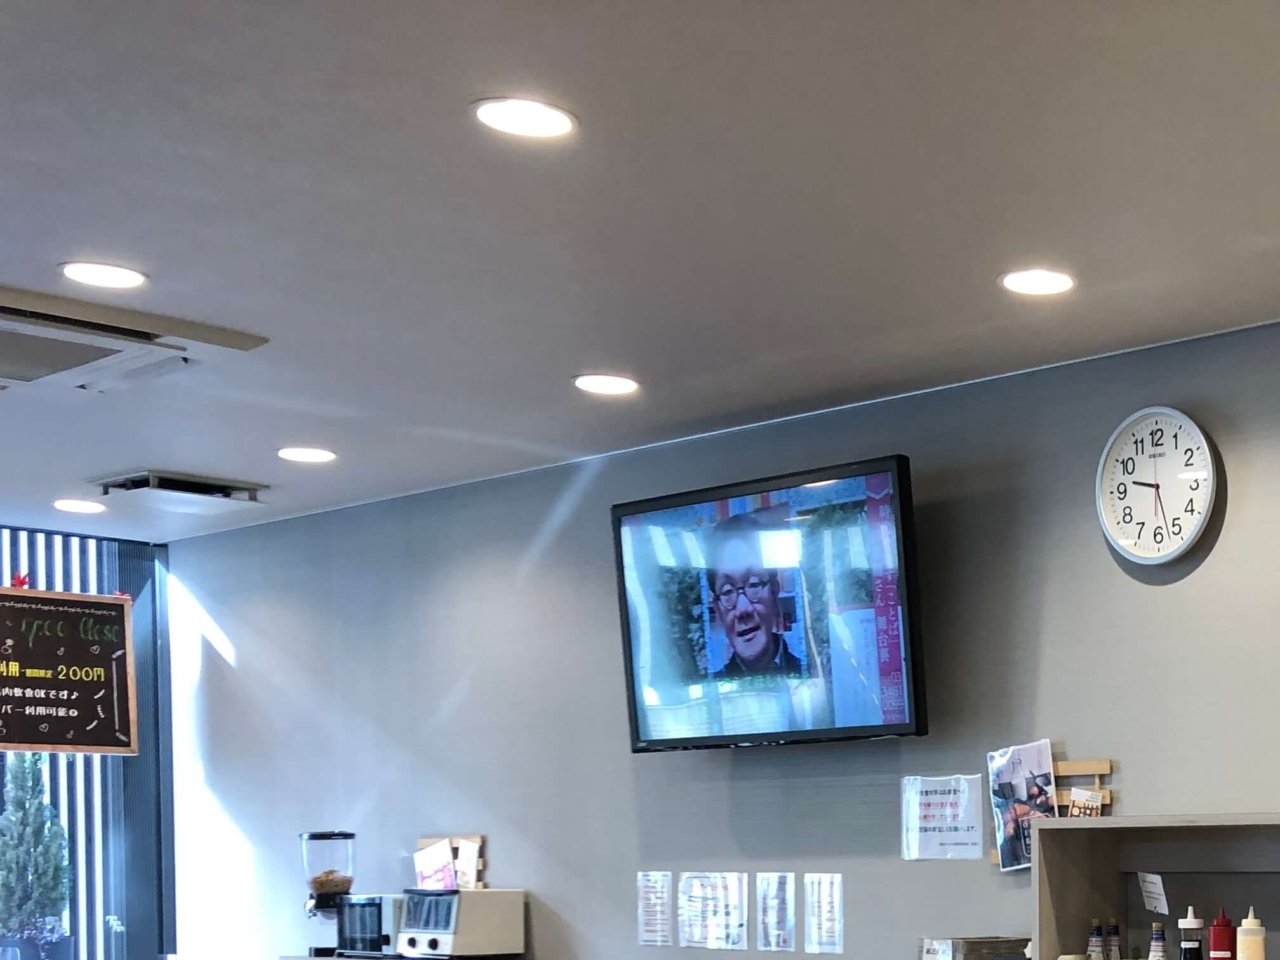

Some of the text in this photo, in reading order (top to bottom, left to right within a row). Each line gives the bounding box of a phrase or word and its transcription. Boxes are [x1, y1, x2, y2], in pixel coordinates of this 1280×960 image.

[1133, 438, 1144, 456] 11
[1149, 429, 1165, 447] 12
[1173, 432, 1178, 449] 1
[1120, 457, 1135, 475] 10
[1184, 448, 1194, 466] 2
[1117, 482, 1127, 500] 9
[1122, 506, 1133, 524] 8
[1184, 498, 1195, 515] 4
[1136, 522, 1146, 539] 7
[1153, 526, 1164, 544] 6
[1171, 517, 1182, 536] 5
[57, 664, 105, 682] 200円
